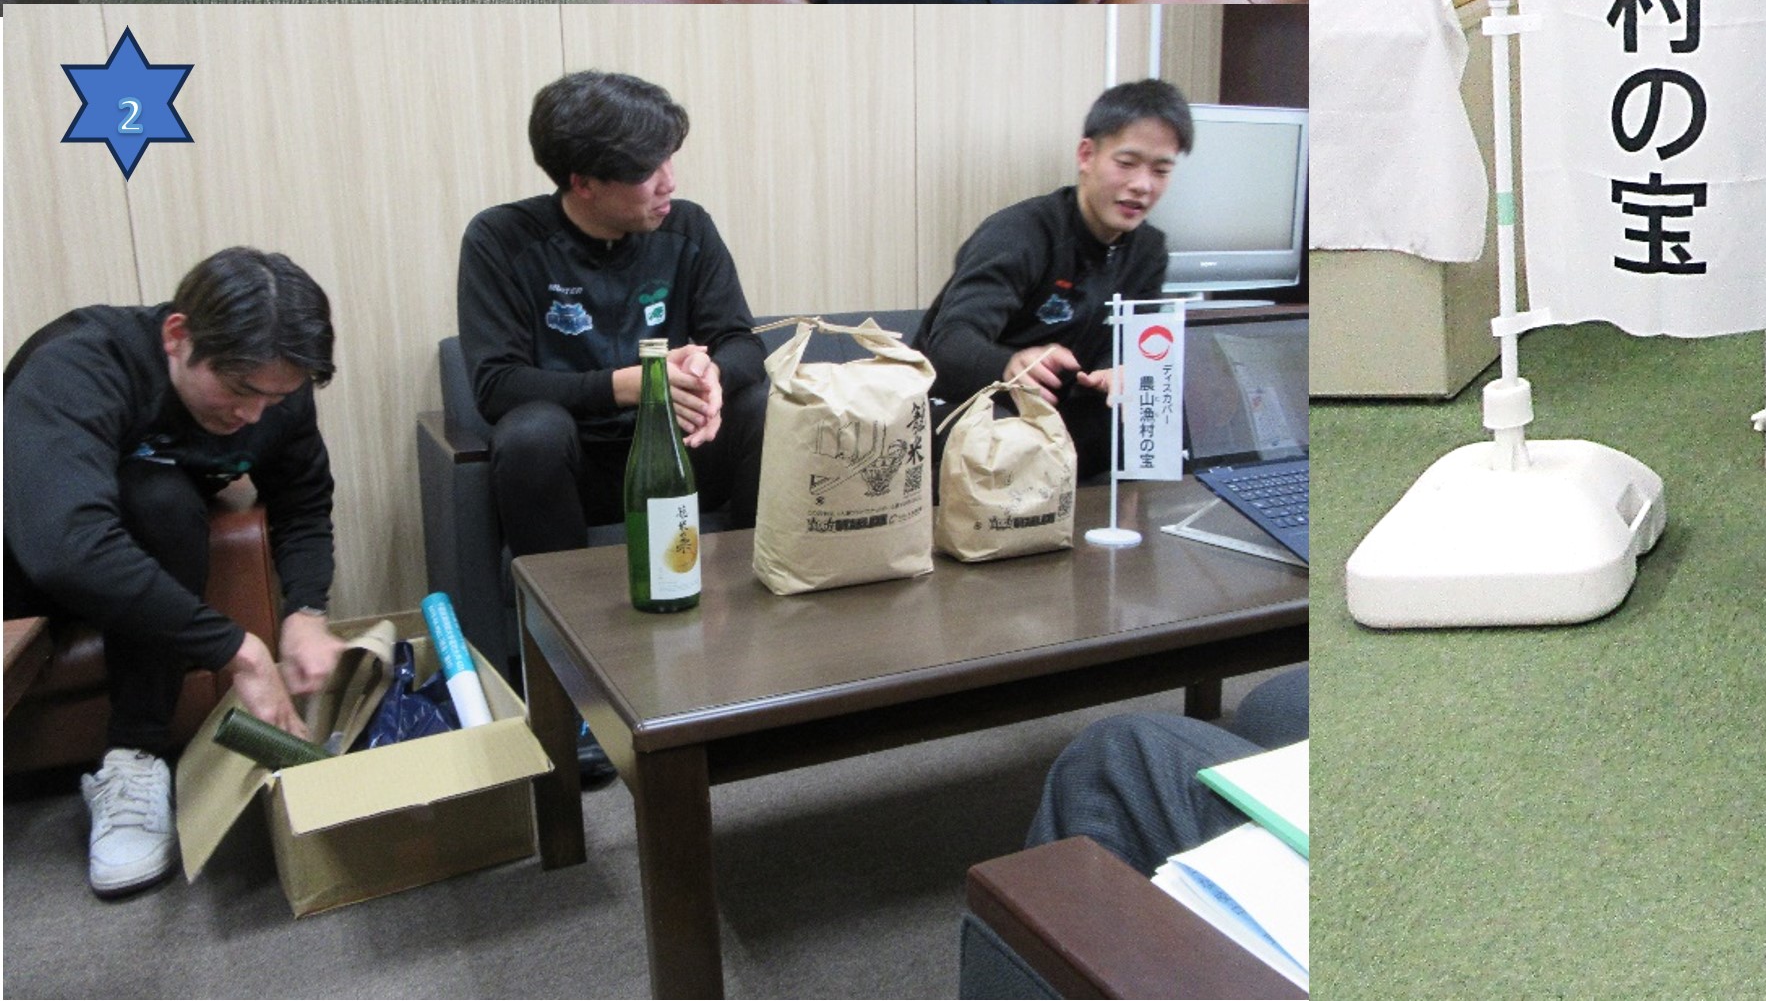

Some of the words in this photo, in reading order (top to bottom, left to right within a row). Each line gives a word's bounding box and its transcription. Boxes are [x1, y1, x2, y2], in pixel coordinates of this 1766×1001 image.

[1138, 375, 1156, 469] 農山漁村の宝
